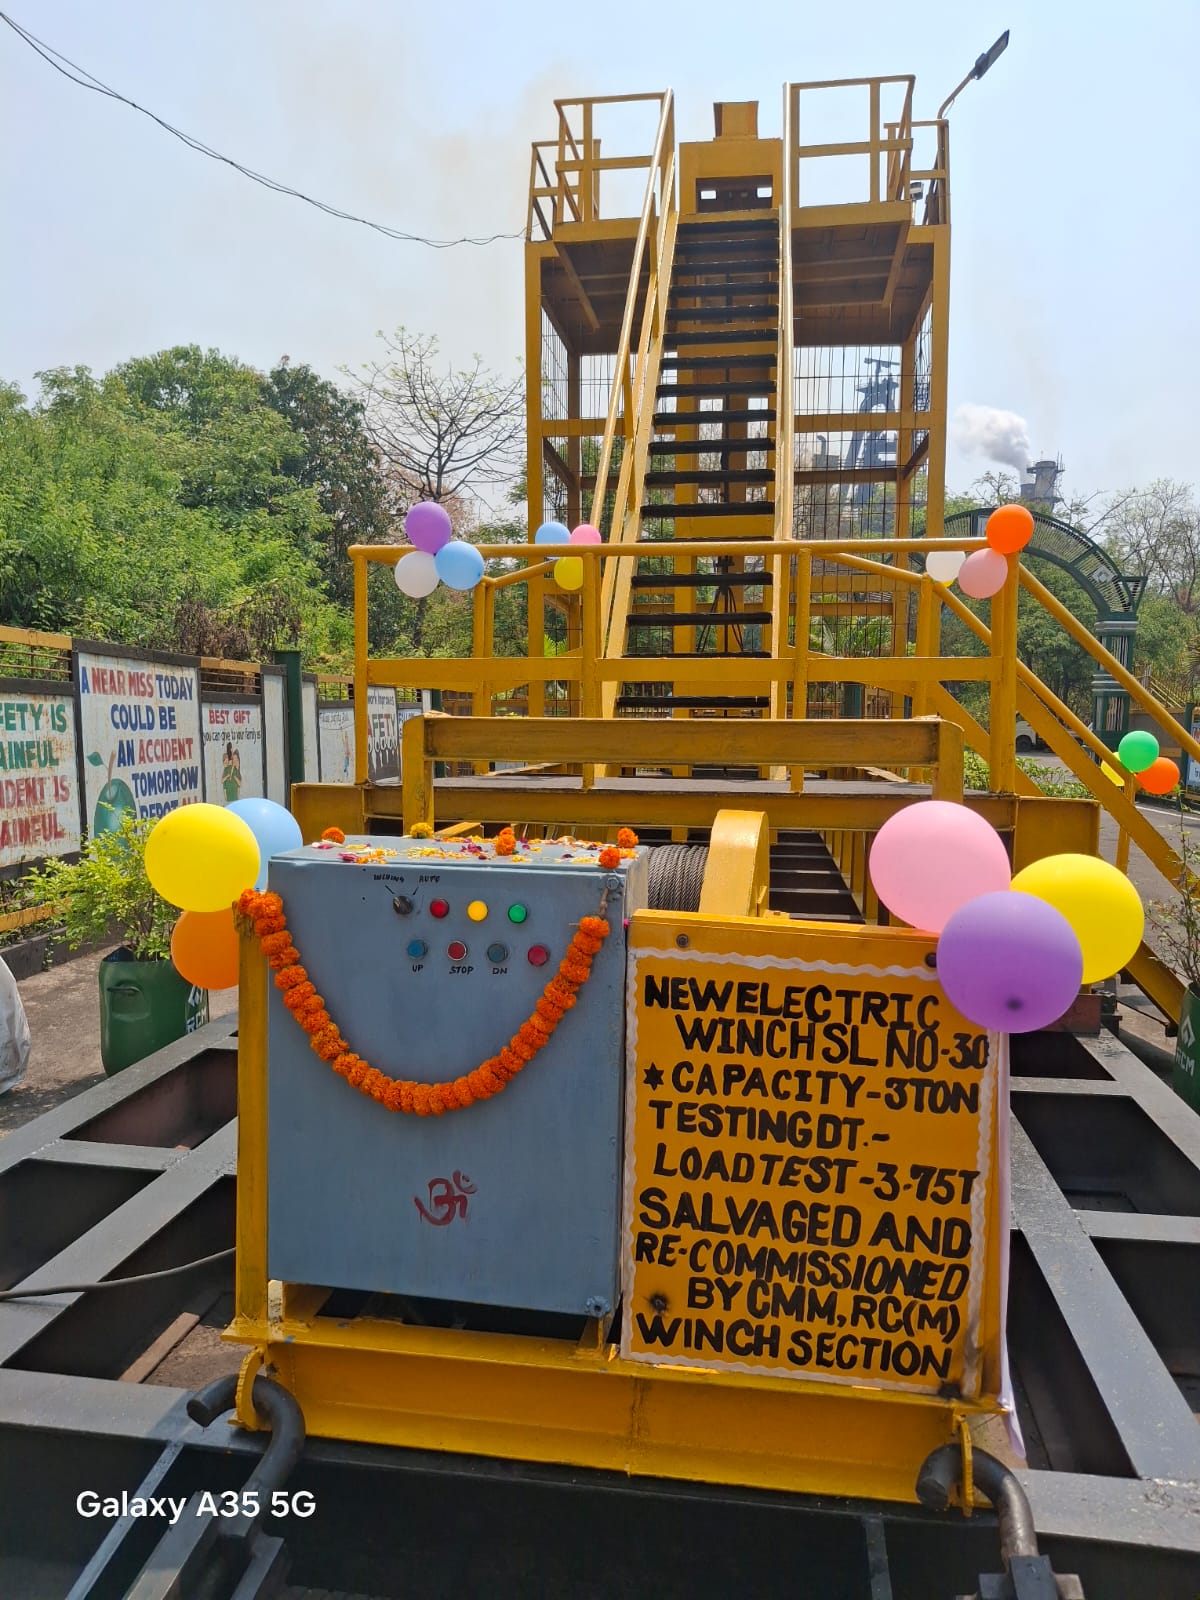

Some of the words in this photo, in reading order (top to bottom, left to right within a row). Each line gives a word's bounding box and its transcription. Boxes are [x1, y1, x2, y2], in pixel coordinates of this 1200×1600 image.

[82, 666, 90, 693] A
[92, 667, 125, 696] NEAR
[128, 672, 154, 698] MISS
[156, 675, 193, 700] TODAY
[50, 704, 67, 732] IS
[111, 704, 155, 731] COULD
[159, 706, 176, 730] BE
[209, 709, 229, 725] BEST
[233, 710, 251, 725] GIFT
[117, 740, 135, 767] AN
[138, 738, 193, 764] ACCIDENT
[54, 775, 70, 803] IS
[132, 766, 198, 798] TOMORROW
[412, 964, 424, 973] UP
[449, 966, 474, 975] STOP
[492, 967, 508, 975] DN
[644, 975, 734, 1012] NEW
[736, 982, 940, 1031] ELECTRIC
[675, 1014, 816, 1061] WINCH
[822, 1024, 878, 1067] SL
[649, 1100, 812, 1149] TESTING
[653, 1143, 755, 1183] LOAD
[639, 1187, 861, 1247] SALVAGED
[868, 1211, 972, 1259] AND
[635, 1232, 969, 1302] RE-COMMISSIONED
[687, 1277, 742, 1311] BY
[635, 1313, 780, 1358] WINCH
[787, 1329, 952, 1379] SECTION
